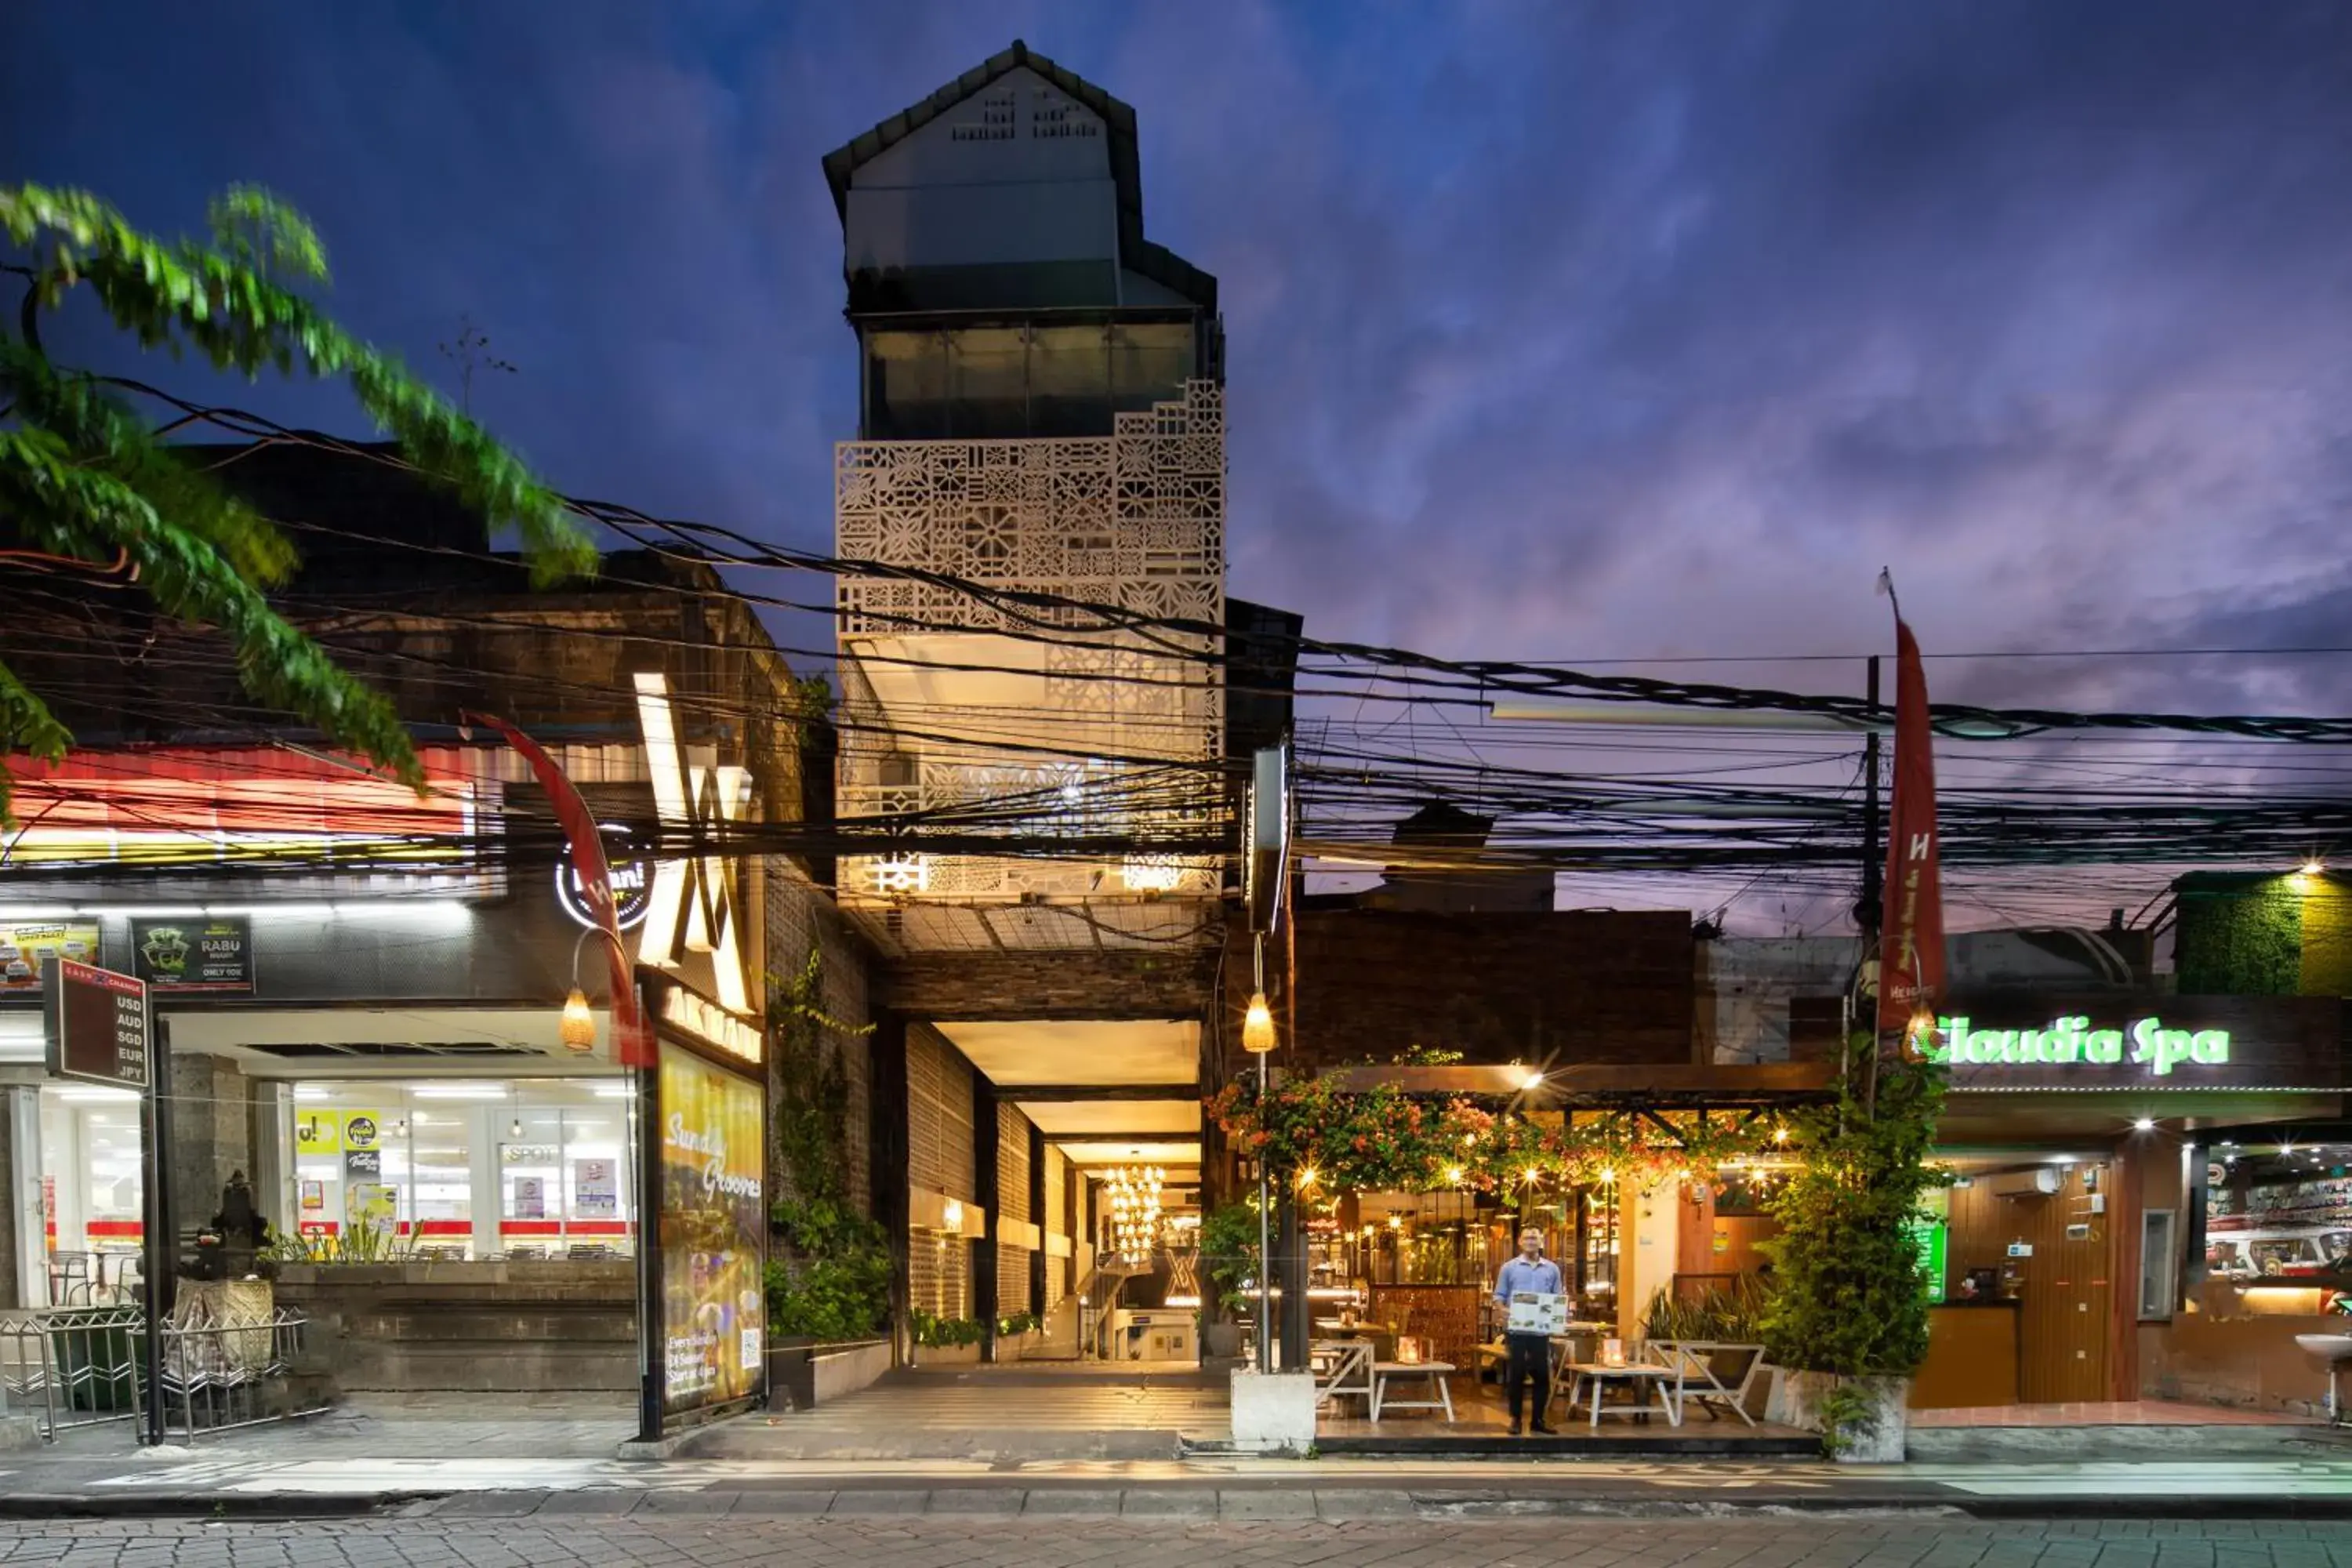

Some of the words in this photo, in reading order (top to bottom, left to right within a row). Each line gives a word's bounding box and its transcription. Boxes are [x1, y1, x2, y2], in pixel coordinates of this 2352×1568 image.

[201, 940, 241, 953] RABU
[203, 967, 225, 977] ONLY
[117, 996, 142, 1011] USD
[117, 1014, 143, 1029] AUD
[118, 1031, 143, 1046] SGD
[2131, 1016, 2230, 1076] Spa
[118, 1047, 143, 1062] EUR
[119, 1065, 143, 1079] JPY
[664, 1112, 728, 1174] Sunday
[702, 1158, 761, 1203] Grooves
